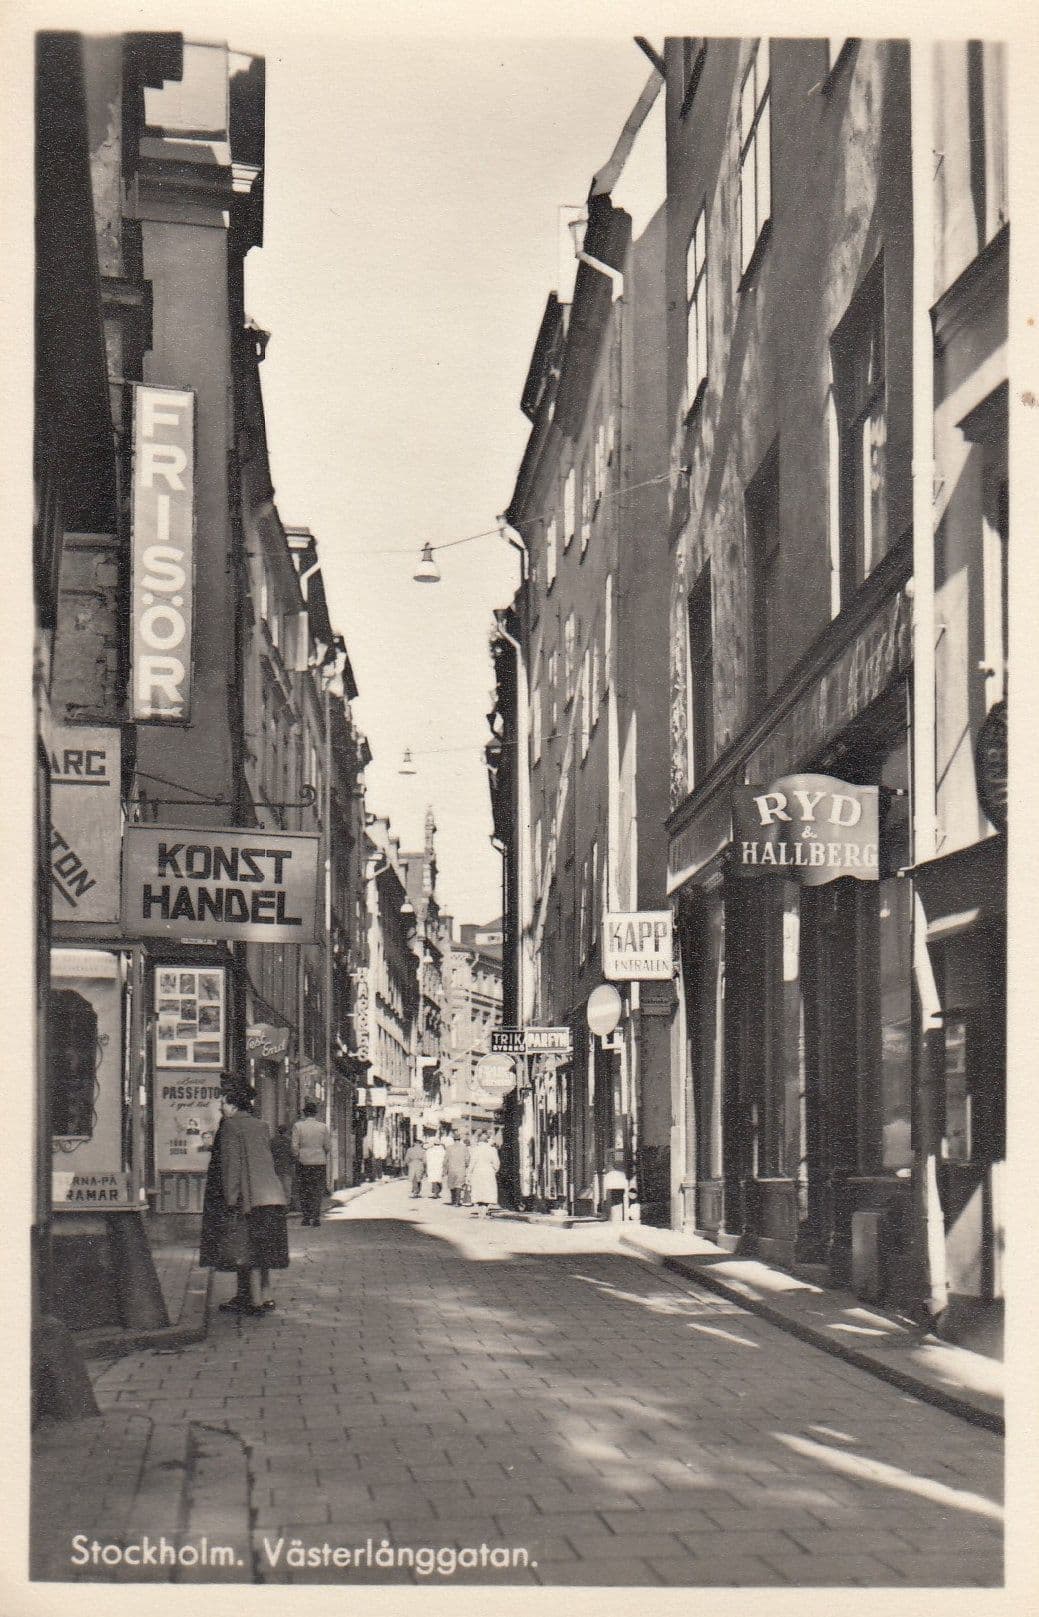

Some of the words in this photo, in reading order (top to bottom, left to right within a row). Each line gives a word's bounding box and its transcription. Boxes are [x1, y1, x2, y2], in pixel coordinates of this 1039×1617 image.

[138, 390, 189, 702] FRISÖR
[753, 790, 862, 826] RYD
[801, 825, 818, 839] &
[157, 842, 293, 885] KONST
[741, 841, 879, 867] HALLBERG
[142, 884, 303, 926] HANDEL
[608, 921, 668, 953] KAPP
[162, 1086, 221, 1099] PASSFOTO
